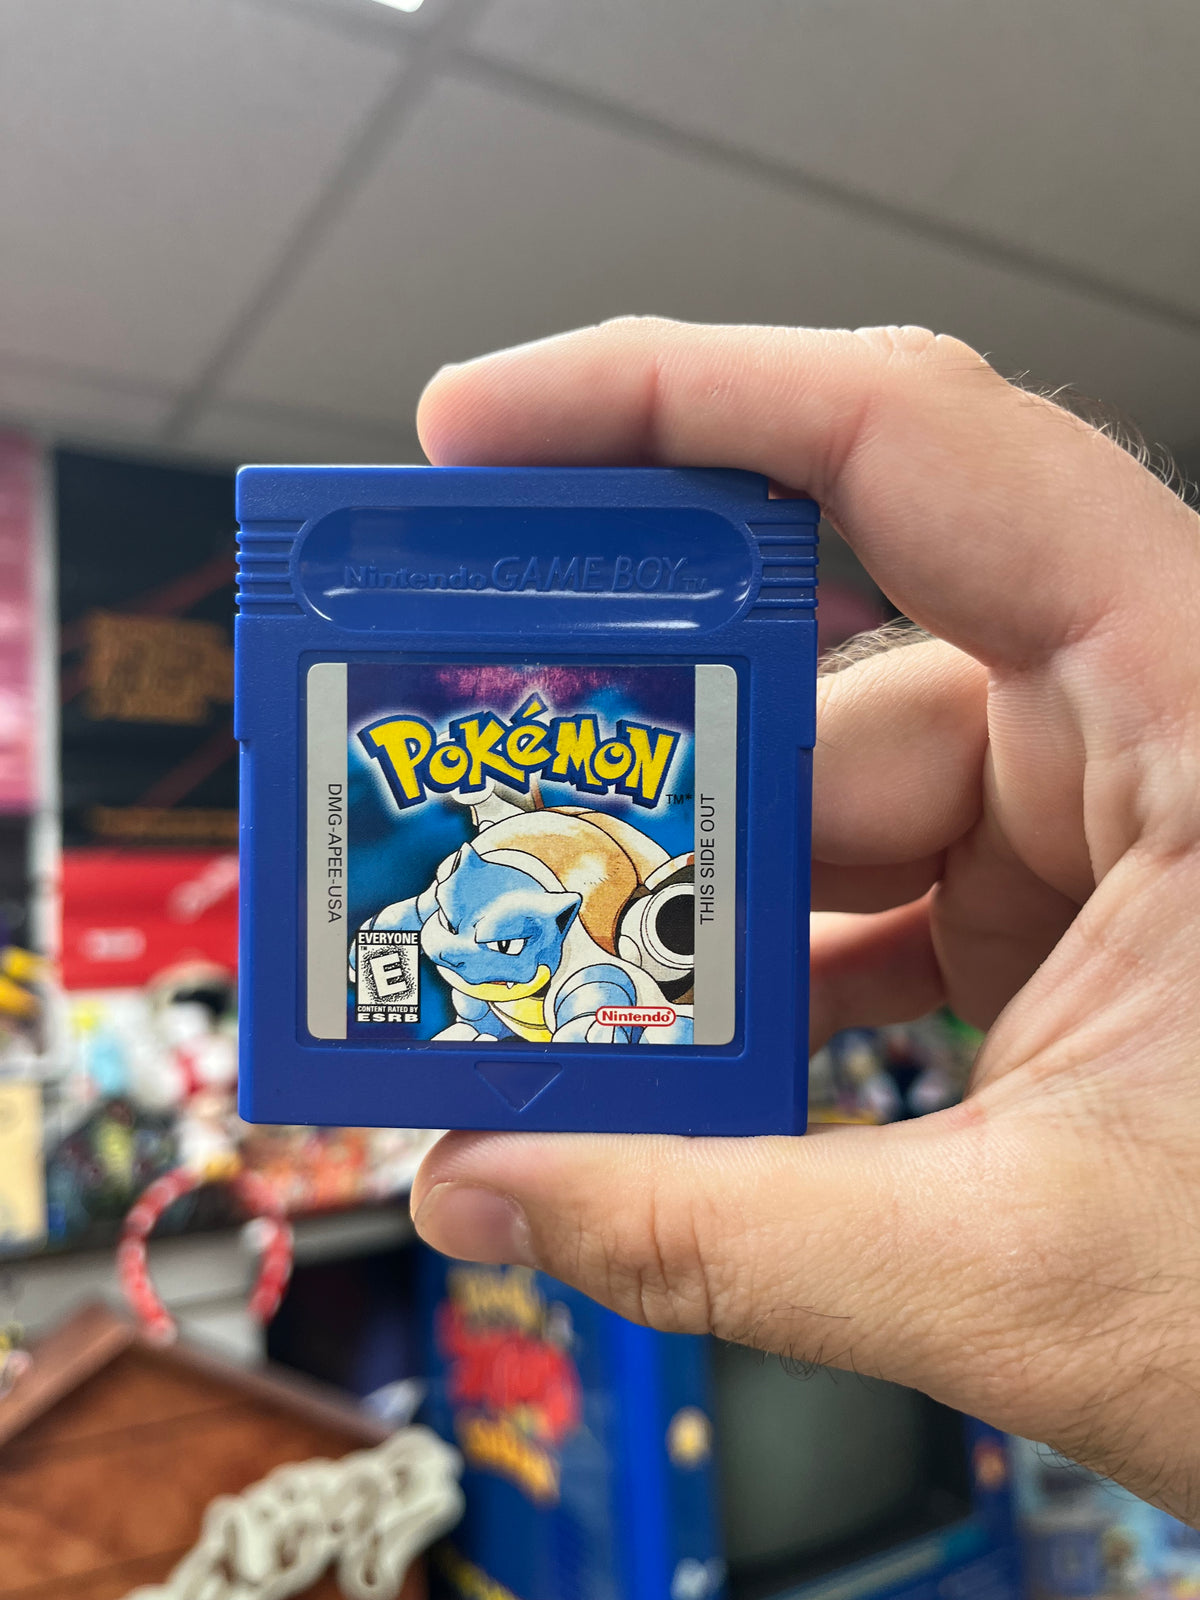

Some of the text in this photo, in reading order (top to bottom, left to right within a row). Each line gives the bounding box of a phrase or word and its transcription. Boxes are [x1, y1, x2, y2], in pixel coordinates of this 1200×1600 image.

[344, 564, 487, 590] Nintendo
[491, 556, 604, 591] GAME
[611, 556, 688, 591] BOY
[327, 783, 343, 924] DMG-APEE-USA
[699, 793, 715, 926] THIS SIDE OUT
[358, 932, 419, 945] EVERYONE
[369, 952, 410, 997] E
[357, 1005, 419, 1013] CONTENT RATED BY
[357, 1013, 419, 1023] ESRB
